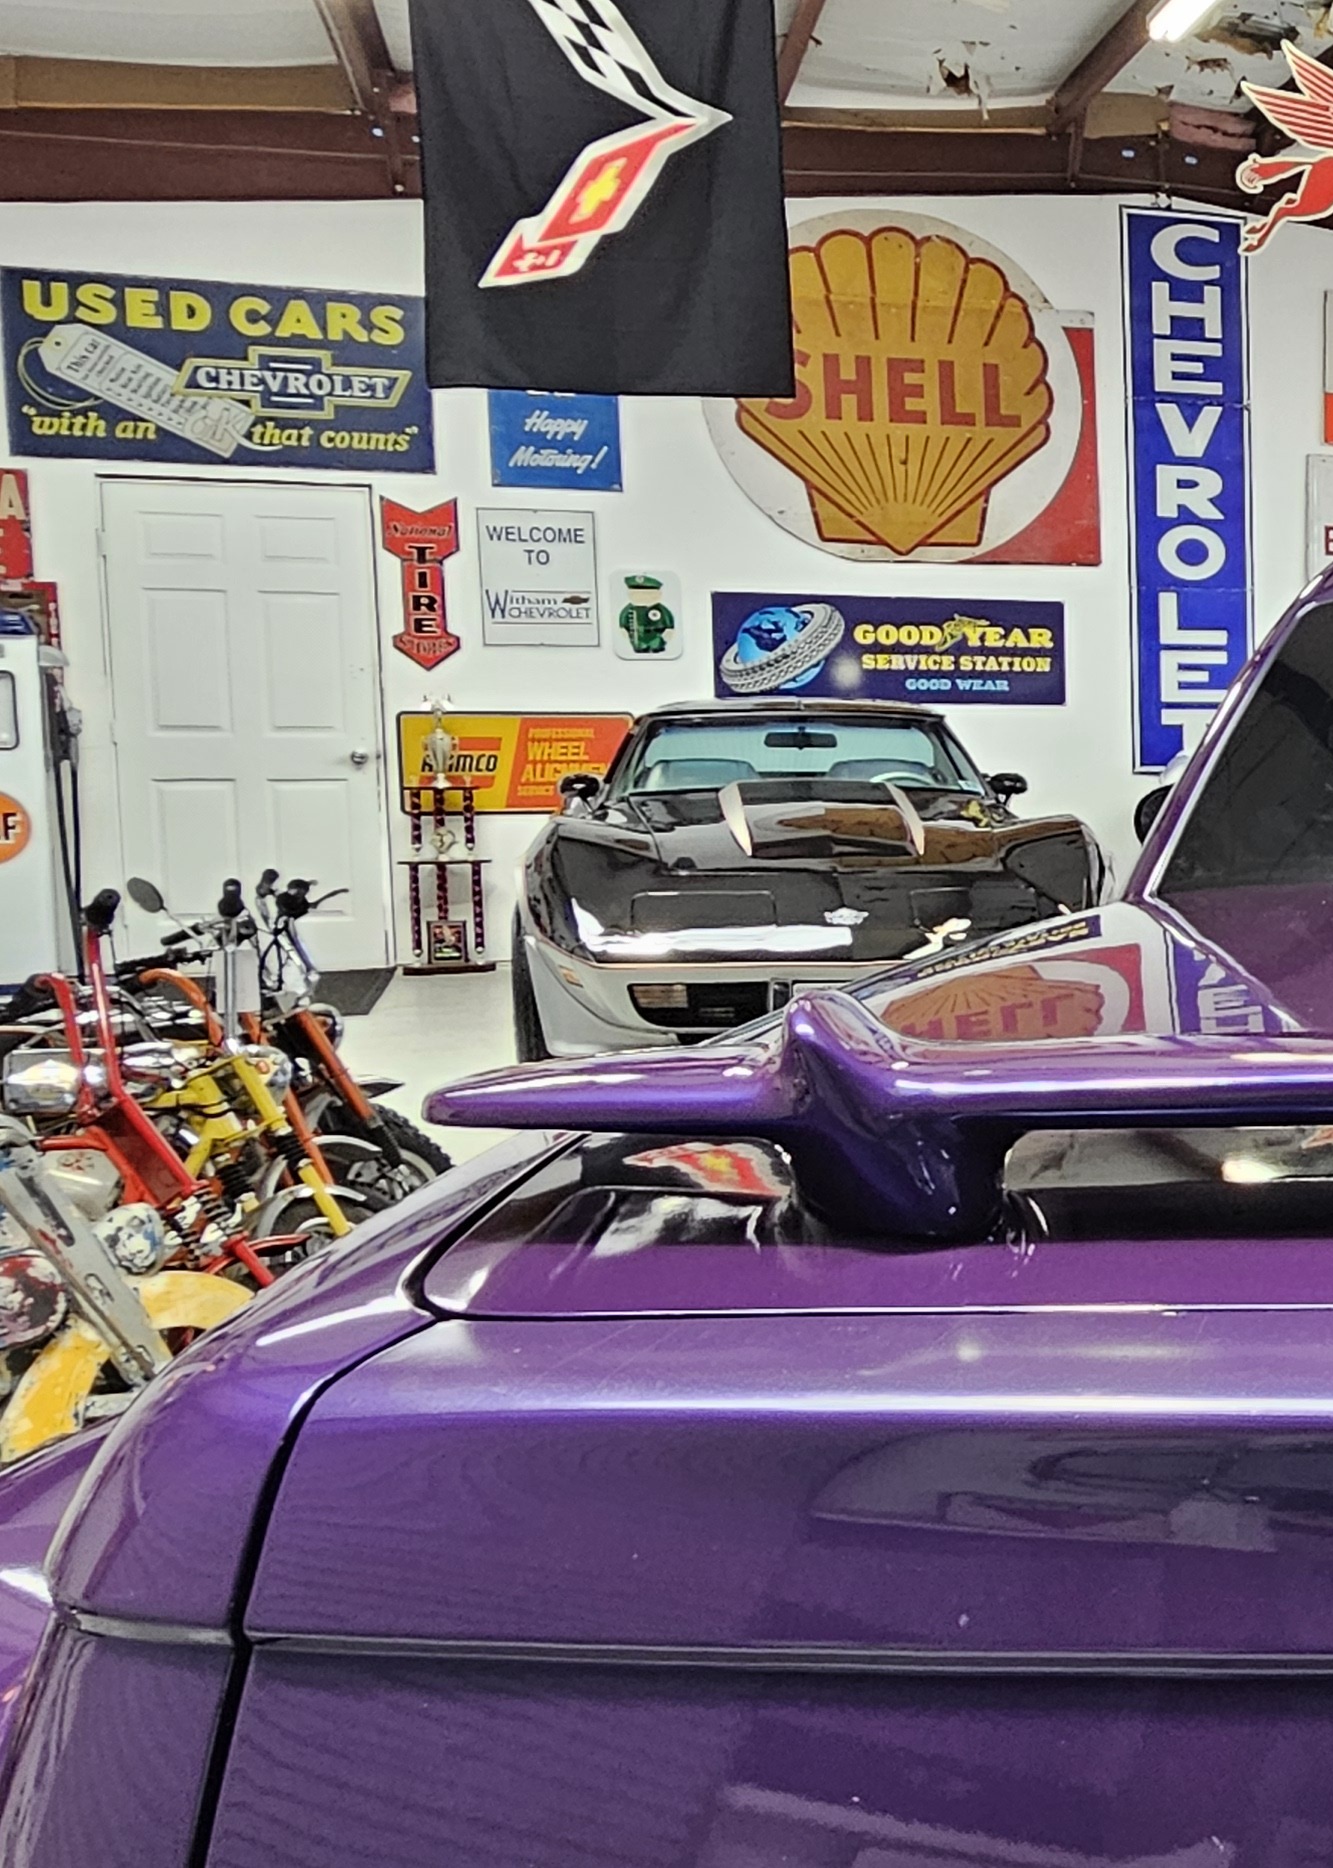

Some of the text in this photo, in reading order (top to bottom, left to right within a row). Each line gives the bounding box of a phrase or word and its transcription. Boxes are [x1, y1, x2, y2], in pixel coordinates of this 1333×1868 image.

[22, 279, 405, 346] USED CARS
[196, 366, 390, 398] CHEVROLET
[764, 350, 1022, 428] SHELL
[115, 420, 157, 441] an
[251, 421, 312, 448] that
[524, 409, 588, 441] Happy
[508, 445, 609, 474] Motoring!
[1150, 223, 1229, 764] CHEVROLET
[485, 525, 585, 544] WELCOME
[523, 549, 550, 566] TO
[406, 545, 440, 635] TIRE
[509, 606, 591, 619] CHEVROLET
[861, 653, 1052, 674] SERVICE STATION
[904, 677, 1010, 692] GOOD WEAR
[527, 740, 590, 761] WHEEL
